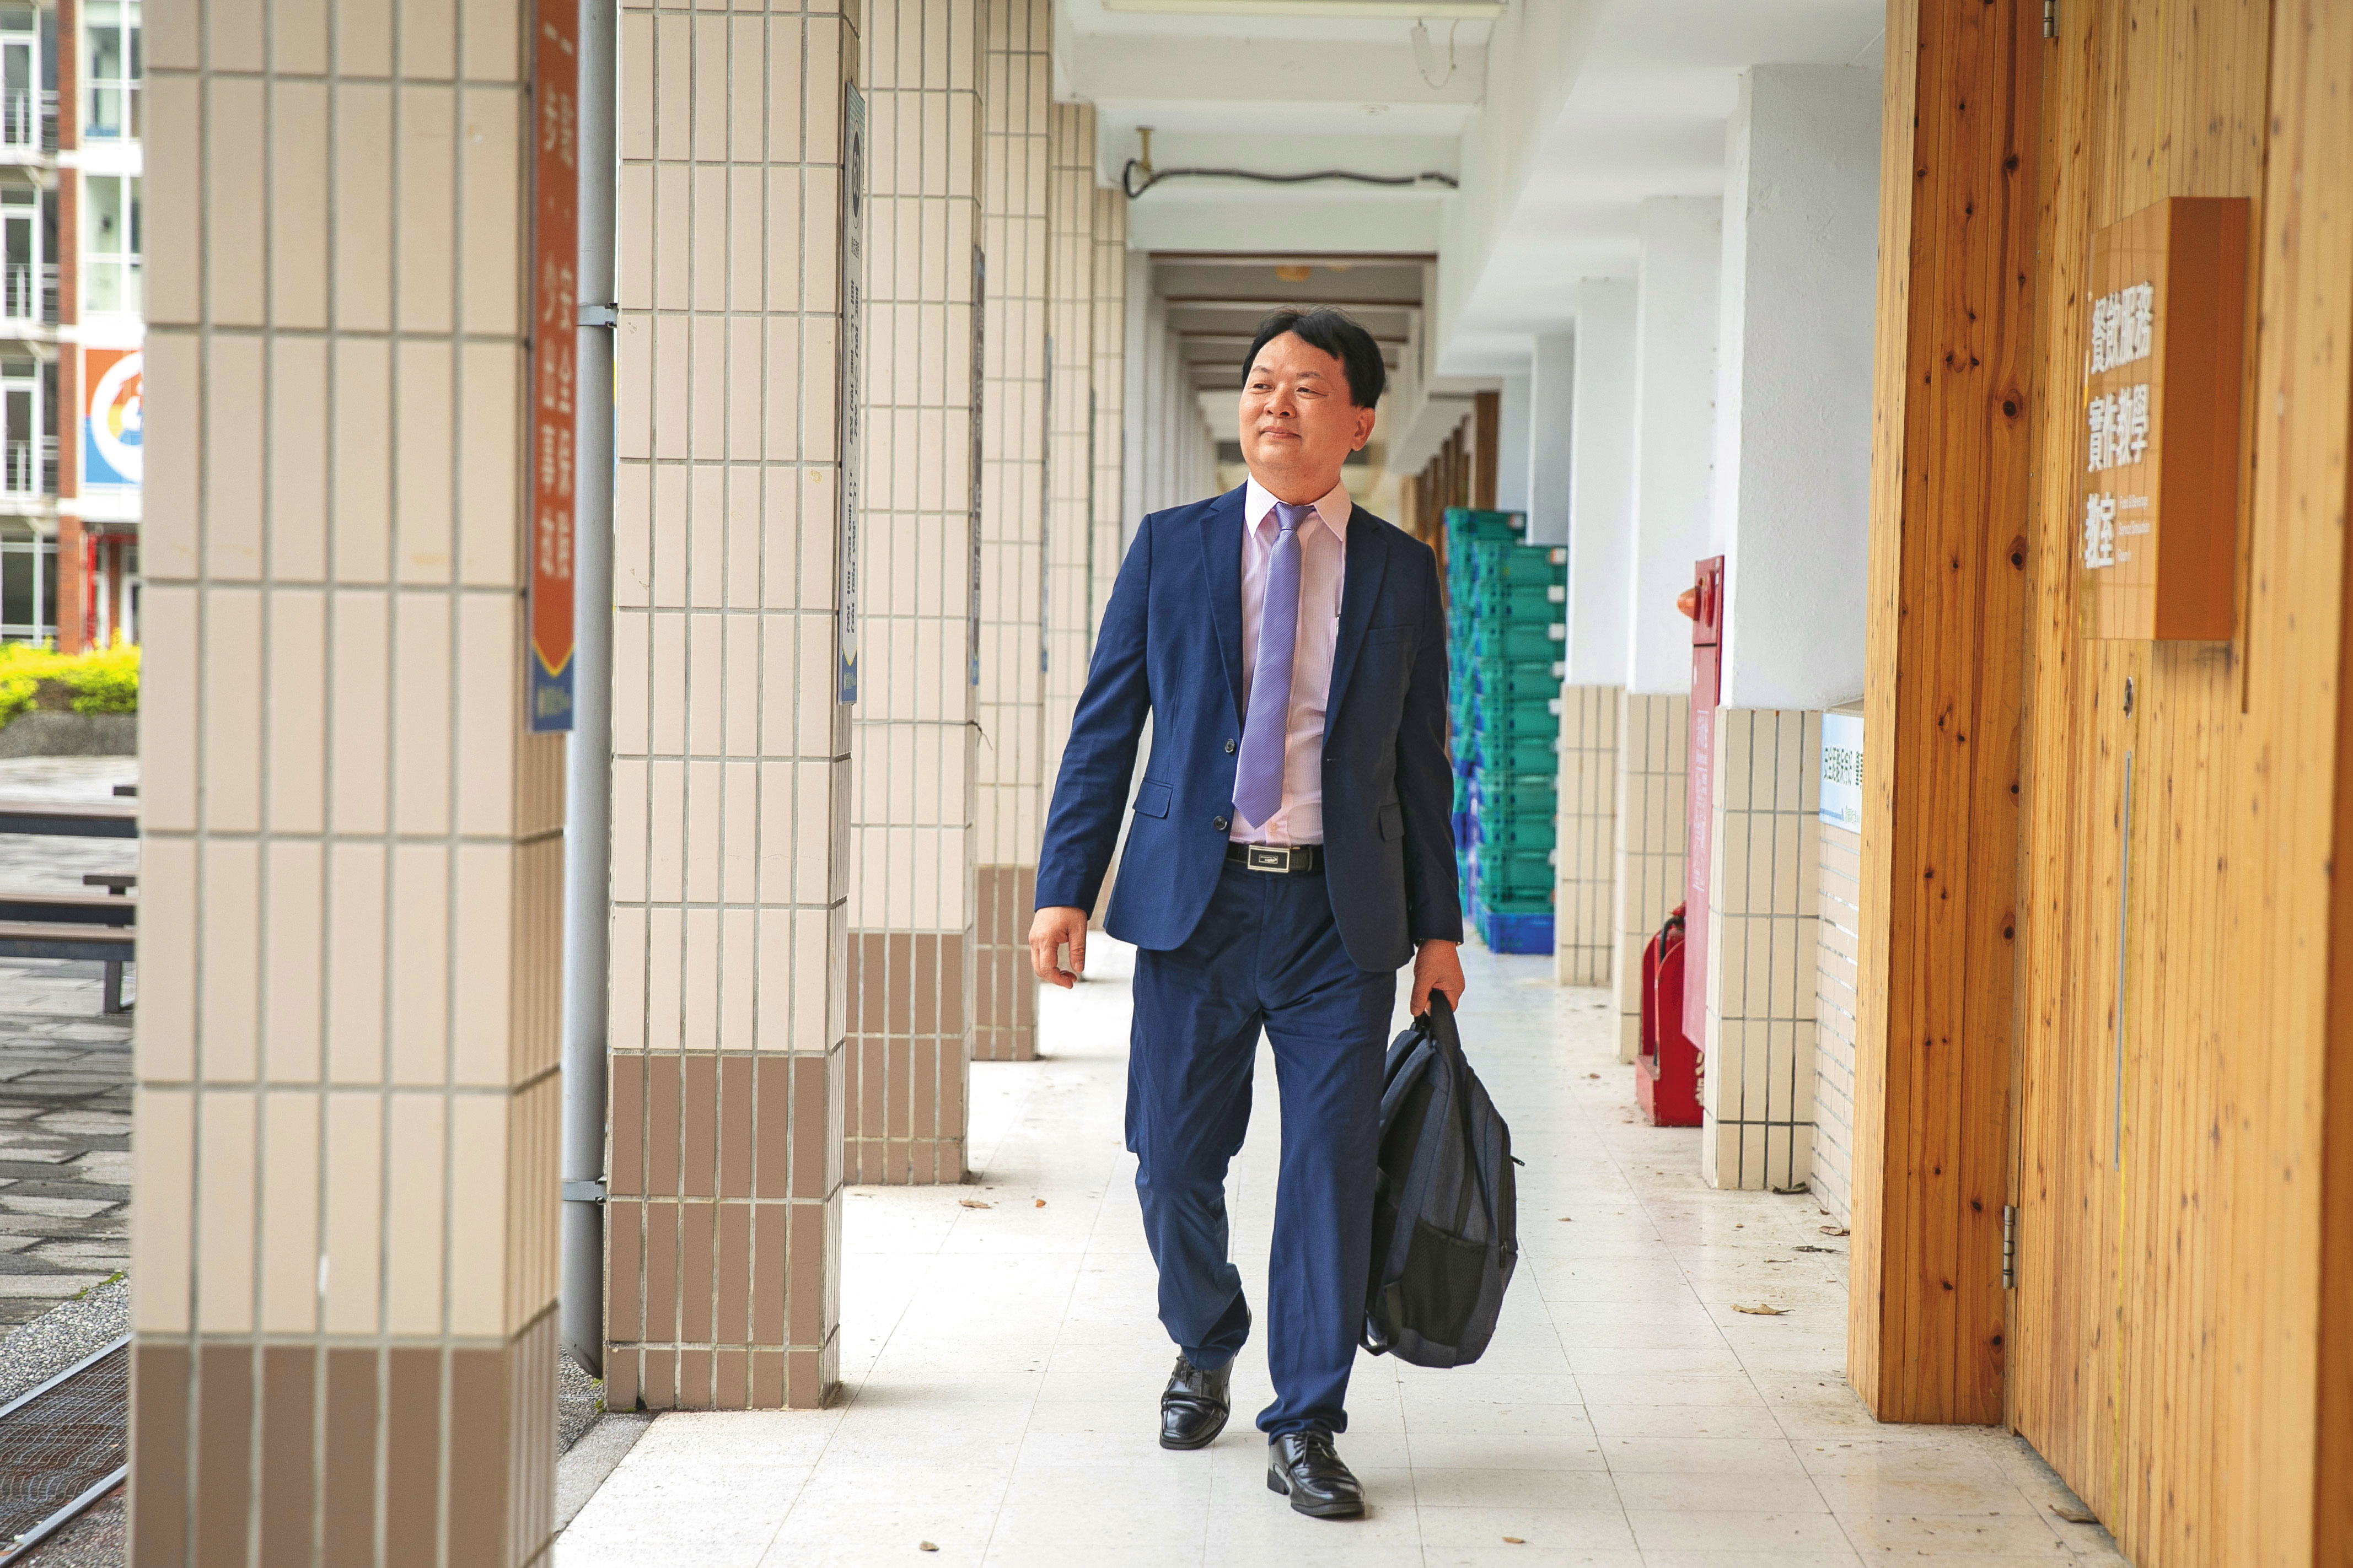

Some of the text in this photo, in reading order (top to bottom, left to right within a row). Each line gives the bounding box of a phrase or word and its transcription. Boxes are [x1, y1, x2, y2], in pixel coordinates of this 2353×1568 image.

[853, 150, 859, 198] 60
[2091, 281, 2154, 374] 餐飲服務
[2088, 384, 2150, 473] 實作教學
[2119, 495, 2129, 509] Food
[2132, 494, 2148, 509] Beverage
[2085, 492, 2116, 569] 教室
[2119, 522, 2131, 535] Service
[2118, 548, 2128, 561] Room
